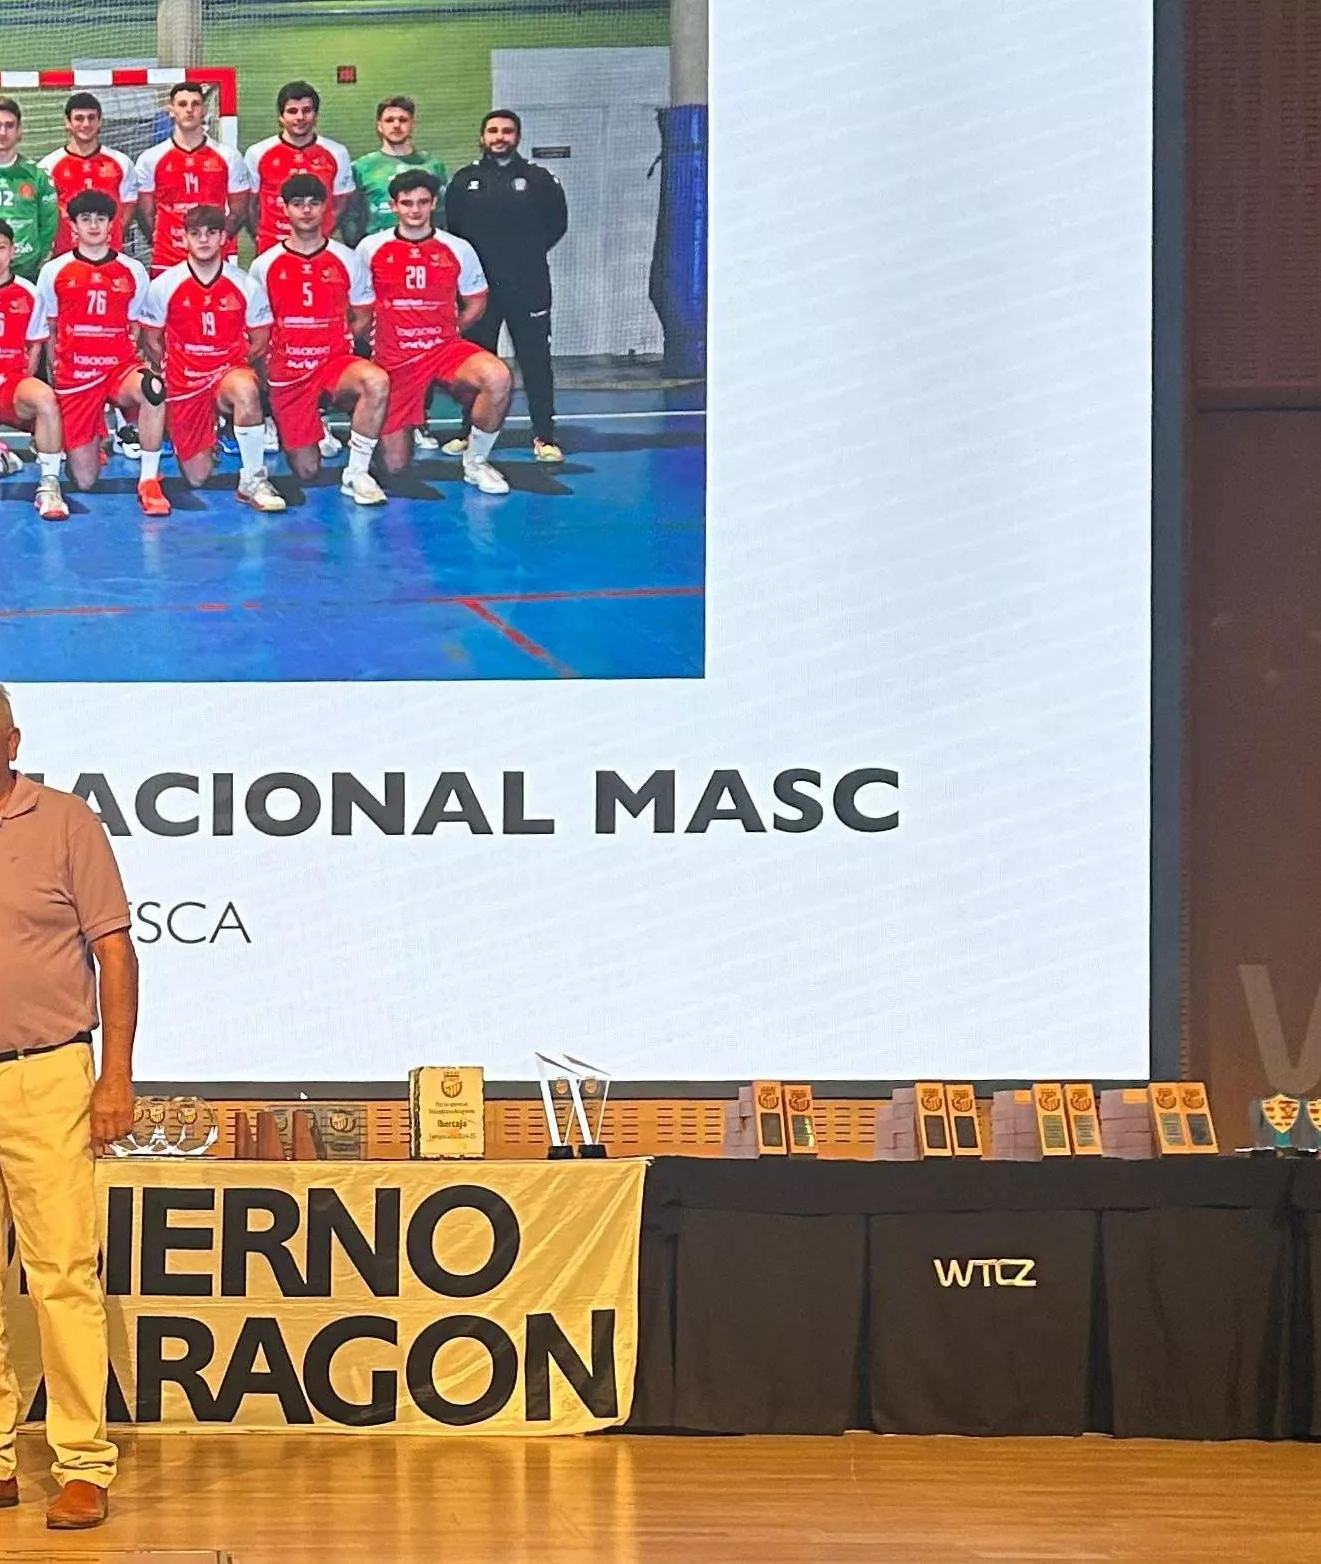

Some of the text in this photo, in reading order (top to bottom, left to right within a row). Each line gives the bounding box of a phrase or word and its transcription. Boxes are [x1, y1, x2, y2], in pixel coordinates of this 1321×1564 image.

[183, 172, 199, 193] 14
[405, 266, 426, 289] 28
[87, 290, 107, 315] 76
[302, 282, 313, 306] 5
[201, 312, 216, 336] 19
[24, 770, 554, 836] ACIONAL
[595, 768, 901, 834] MASC
[129, 901, 251, 944] SCA
[934, 1259, 1036, 1288] WTCZ
[25, 1309, 619, 1426] RAGON
